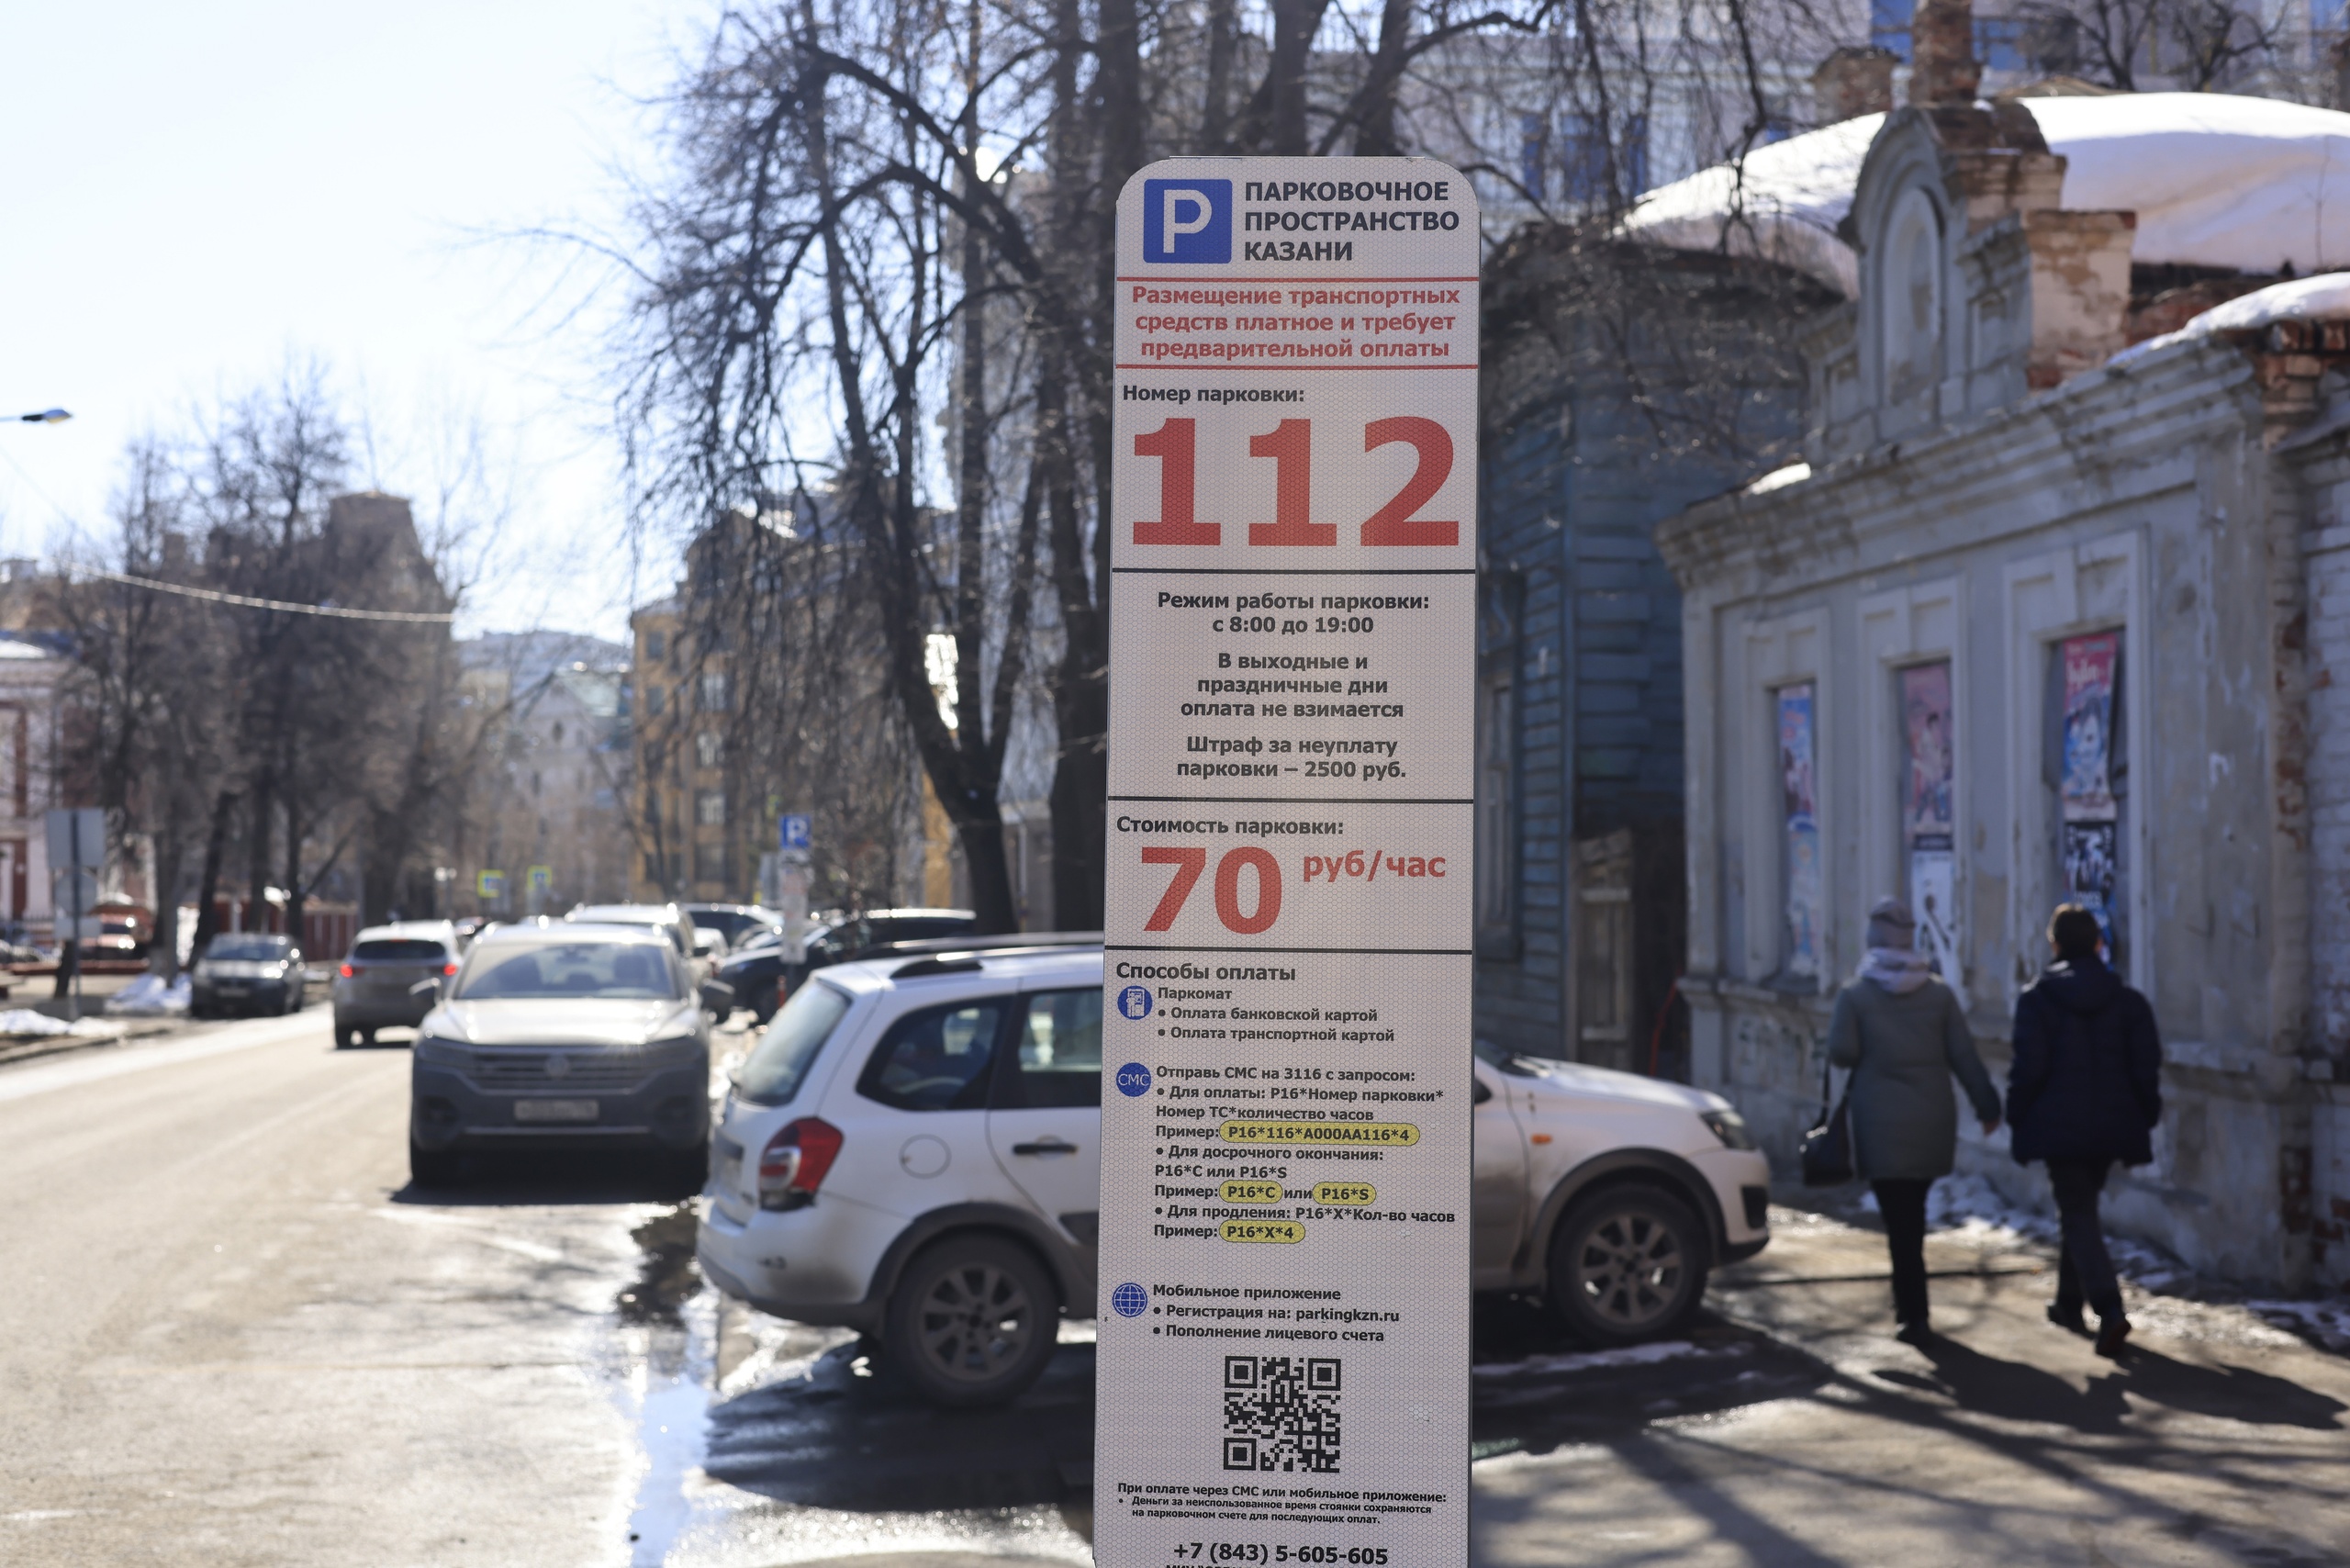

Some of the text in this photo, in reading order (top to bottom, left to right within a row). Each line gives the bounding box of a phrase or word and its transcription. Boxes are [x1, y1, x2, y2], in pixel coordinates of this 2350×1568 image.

[1246, 182, 1448, 201] ПАРКОВОЧНОЕ
[1164, 190, 1212, 252] P
[1246, 211, 1459, 230] ПРОСТРАНСТВО
[1246, 241, 1352, 261] КАЗАНИ
[1133, 286, 1460, 308] Размещение транспортных
[1136, 313, 1455, 334] средств платное и требует
[1142, 339, 1449, 361] предварительной оплаты
[1124, 386, 1304, 405] Номер парковки:
[1133, 417, 1459, 546] 112
[1158, 592, 1428, 612] Режим работы парковки:
[1213, 617, 1373, 634] с 8:00 до 19:00
[1219, 653, 1367, 671] В выходные и
[1198, 680, 1387, 696] праздничные дни
[1181, 703, 1403, 717] оплата не взимается
[1188, 736, 1397, 757] Штраф за неуплату
[1178, 764, 1277, 779] парковки
[1305, 761, 1356, 777] 2500
[1363, 761, 1405, 781] руб.
[787, 817, 809, 845] P
[1117, 816, 1343, 837] Стоимость парковки:
[1142, 846, 1445, 934] 70 руб/час
[1116, 962, 1295, 980] Способы оплаты
[1158, 987, 1232, 1002] Паркомат
[1171, 1007, 1377, 1024] Оплата банковской картой
[1170, 1027, 1394, 1043] Оплата транспортной картой
[1118, 1074, 1149, 1086] СМС
[1157, 1066, 1415, 1083] Отправь СМС на 3116 с запросом:
[1169, 1086, 1199, 1099] Для
[1204, 1089, 1265, 1098] оплаты:
[1157, 1105, 1205, 1120] Номер
[1330, 1111, 1373, 1123] часов
[1156, 1126, 1219, 1140] Пример:
[1169, 1146, 1382, 1160] Для досрочного окончания:
[1207, 1169, 1235, 1177] или
[1155, 1185, 1217, 1199] Пример:
[1284, 1190, 1313, 1199] или
[1168, 1205, 1197, 1218] Для
[1203, 1208, 1290, 1220] продления:
[1412, 1213, 1455, 1222] часов
[1155, 1225, 1217, 1239] Пример:
[1154, 1284, 1340, 1300] Мобильное приложение
[1167, 1305, 1399, 1323] Регистрация на: parkingkzn.ru
[1167, 1325, 1383, 1341] Пополнение лицевого счета
[1118, 1484, 1142, 1495] При
[1192, 1486, 1228, 1497] через
[1232, 1486, 1259, 1495] СМС
[1290, 1488, 1359, 1499] мобильное
[1363, 1492, 1446, 1502] приложение:
[1132, 1496, 1169, 1506] Деньги
[1186, 1500, 1281, 1508] неиспользованное
[1364, 1506, 1431, 1514] сохраняются
[1147, 1510, 1215, 1518] парковочном
[1271, 1514, 1344, 1523] последующих
[1174, 1543, 1388, 1565] +7 (843) 5-605-605
